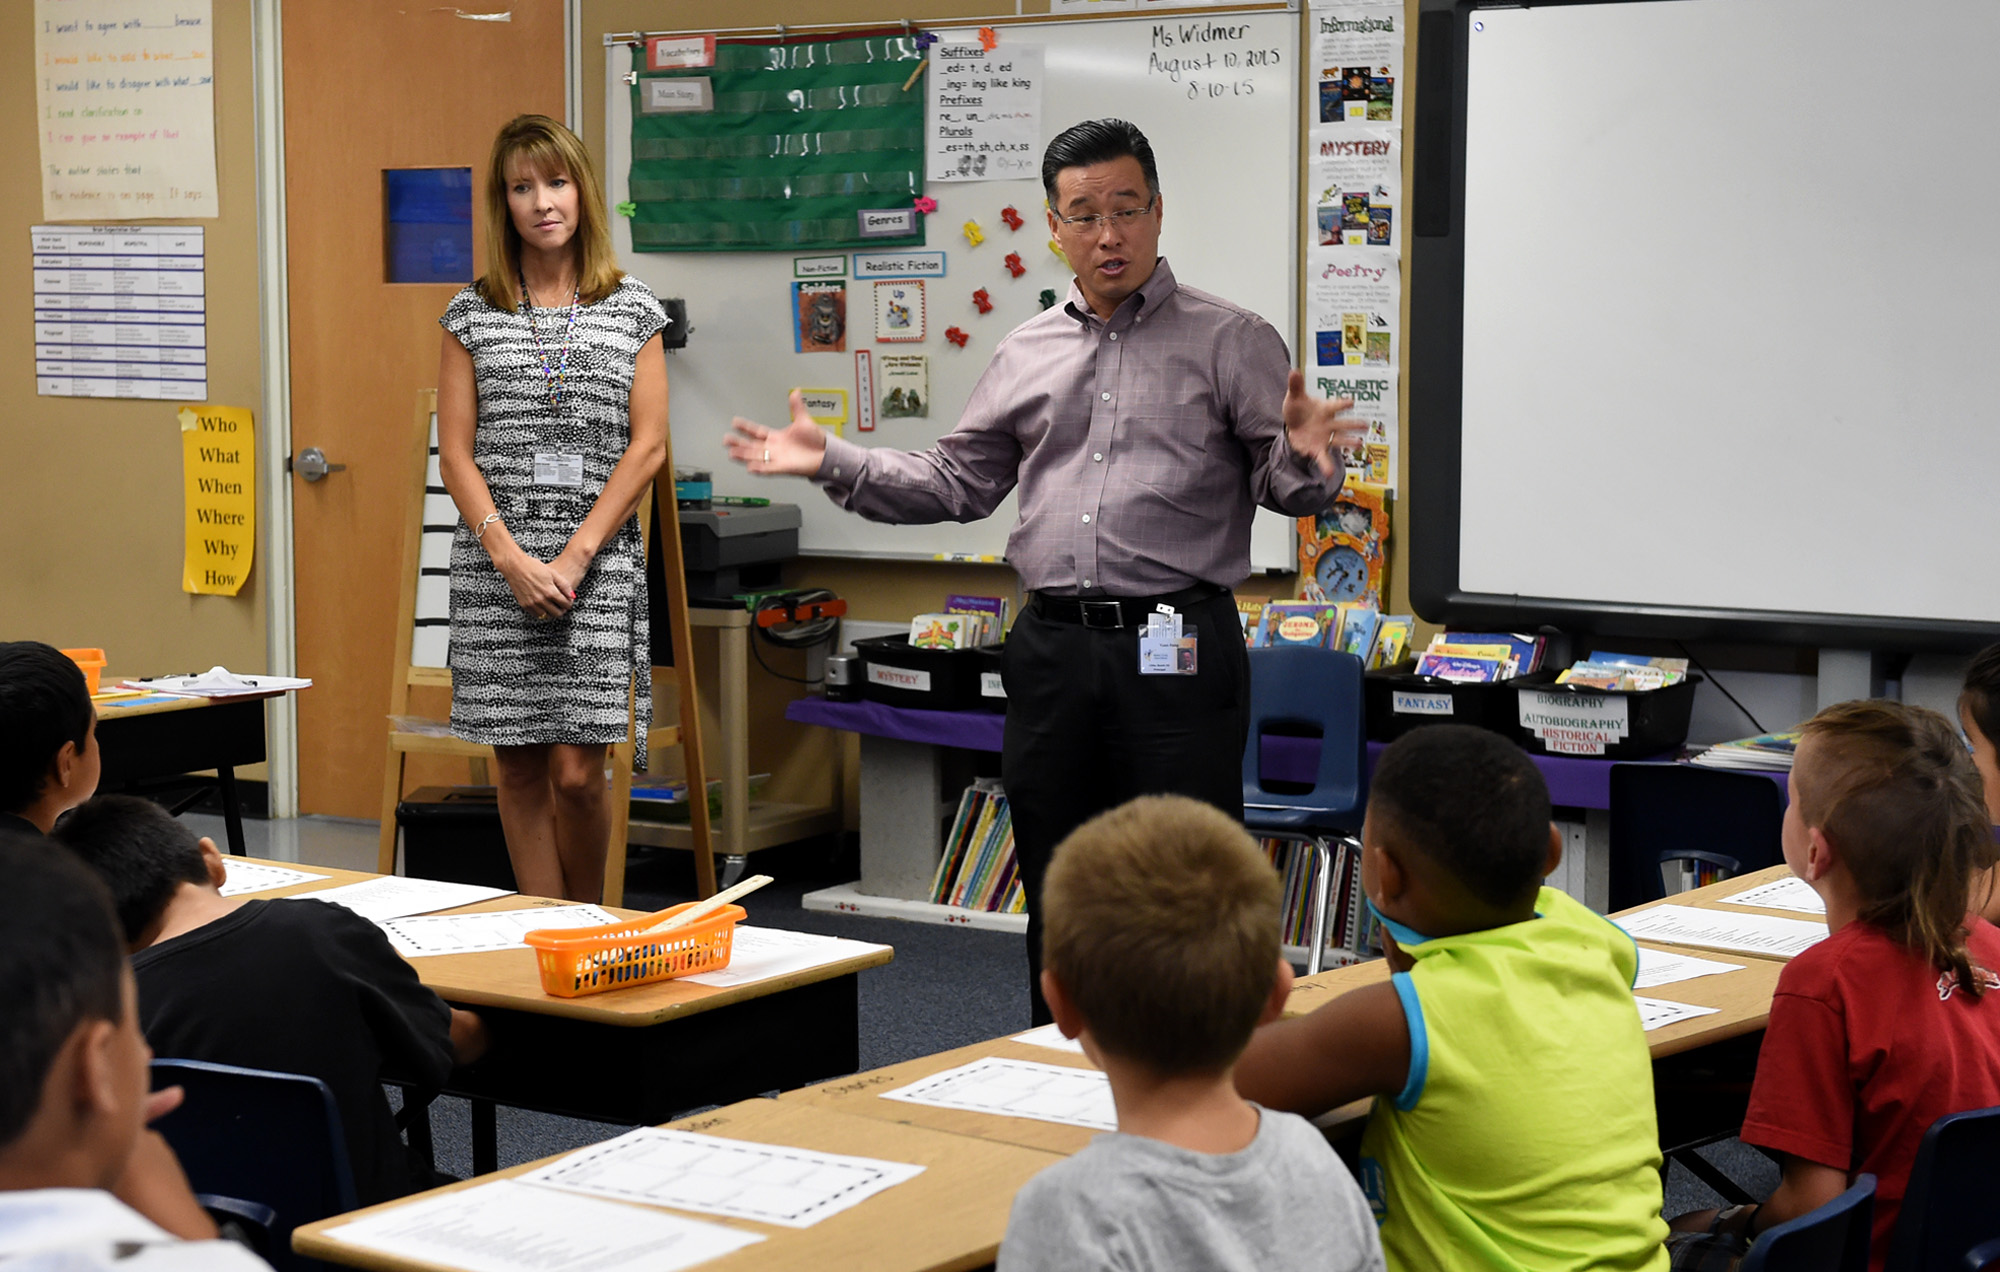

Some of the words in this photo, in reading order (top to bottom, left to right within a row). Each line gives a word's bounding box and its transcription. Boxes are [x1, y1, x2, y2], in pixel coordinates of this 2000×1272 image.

[44, 20, 50, 33] I
[56, 19, 78, 33] want
[85, 20, 93, 31] to
[98, 22, 118, 36] agree
[1179, 21, 1251, 44] Widmer
[940, 47, 985, 58] Suffixes
[999, 62, 1012, 72] ed
[1149, 52, 1217, 83] August
[1246, 48, 1280, 67] 2015
[86, 79, 100, 91] like
[107, 78, 116, 89] to
[972, 80, 986, 91] ing
[990, 78, 1008, 88] like
[1012, 78, 1031, 90] king
[1187, 79, 1255, 100] 8-10-15
[940, 95, 982, 106] Prefixes
[940, 126, 973, 136] Plurals
[1320, 140, 1391, 157] MYSTERY
[867, 215, 904, 226] Genres
[865, 261, 904, 272] Realistic
[907, 260, 939, 270] Fiction
[1322, 264, 1386, 282] Poetry
[801, 283, 841, 295] Spiders
[893, 290, 905, 299] Up
[1317, 377, 1389, 391] REALISTIC
[1326, 389, 1381, 401] FICTION
[197, 416, 237, 433] Who
[200, 447, 240, 464] What
[198, 478, 242, 495] When
[197, 508, 245, 526] Where
[204, 539, 239, 560] Why
[205, 570, 237, 586] How
[877, 670, 918, 685] MYSTERY
[1397, 697, 1451, 710] FANTASY
[1537, 694, 1605, 709] BIOGRAPHY
[1524, 713, 1624, 730] AUTOBIOGRAPHY
[1542, 728, 1611, 742] HISTORICAL
[1553, 741, 1597, 753] FICTION
